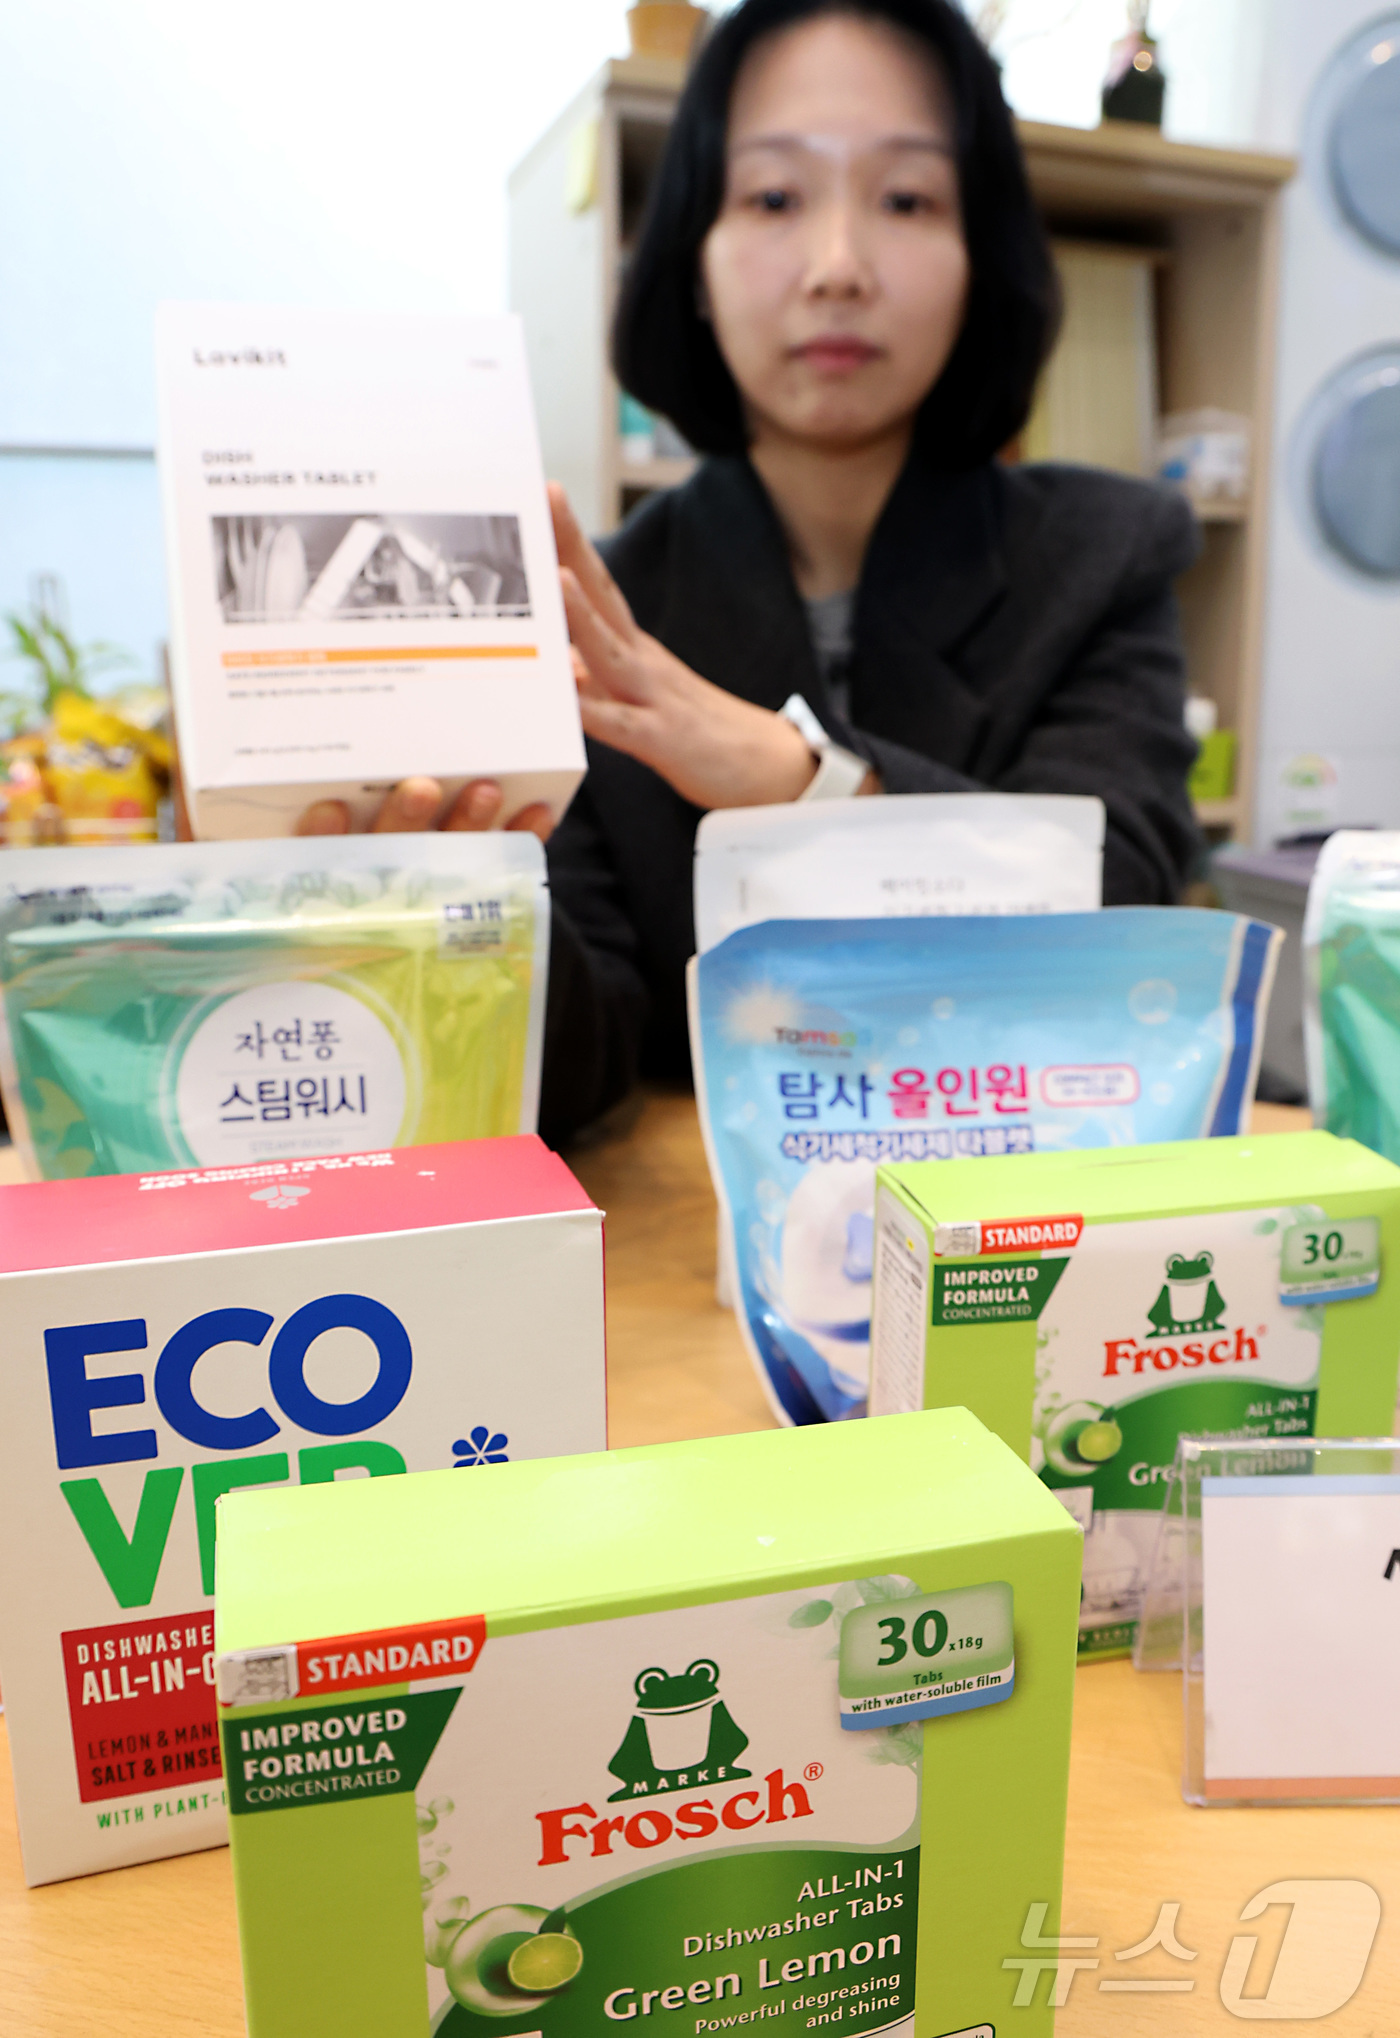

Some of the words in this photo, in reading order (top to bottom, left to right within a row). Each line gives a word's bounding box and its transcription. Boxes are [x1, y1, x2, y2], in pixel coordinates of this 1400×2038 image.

[302, 471, 376, 484] TABLET
[235, 1018, 341, 1061] 자연퐁
[220, 1075, 366, 1122] 스팀워시
[779, 1071, 874, 1120] 탐사
[887, 1063, 1030, 1119] 올인원
[985, 1222, 1078, 1247] STANDARD
[1303, 1231, 1343, 1265] 30
[943, 1287, 1029, 1306] FORMULA
[944, 1267, 1039, 1286] IMPROVED
[942, 1304, 1032, 1320] CONCENTRATED
[1103, 1327, 1260, 1377] Frosch
[44, 1293, 413, 1470] ECO
[1246, 1395, 1309, 1418] ALL-IN-1
[877, 1610, 949, 1666] 30
[307, 1636, 473, 1683] STANDARD
[913, 1671, 943, 1686] Tabs
[852, 1698, 881, 1713] with
[885, 1680, 974, 1705] water-soluble
[976, 1674, 1002, 1688] film
[88, 1735, 151, 1760] LEMON
[157, 1730, 169, 1748] &
[241, 1709, 407, 1751] IMPROVED
[91, 1761, 136, 1786] SALT
[144, 1759, 156, 1777] &
[163, 1746, 221, 1774] RINSE
[243, 1741, 395, 1781] FORMULA
[633, 1767, 727, 1794] MARKE
[245, 1769, 401, 1803] CONCENTRATED
[97, 1807, 144, 1828] WITH
[535, 1768, 815, 1867] Frosch
[797, 1859, 905, 1903] ALL-IN-1
[684, 1907, 839, 1957] Dishwasher
[847, 1891, 905, 1919] Tabs
[603, 1972, 742, 2021] Green
[759, 1933, 902, 1989] Lemon
[696, 2000, 786, 2034] Powerful
[791, 1973, 901, 2011] degreasing
[806, 2007, 846, 2028] and
[848, 1994, 901, 2018] shine
